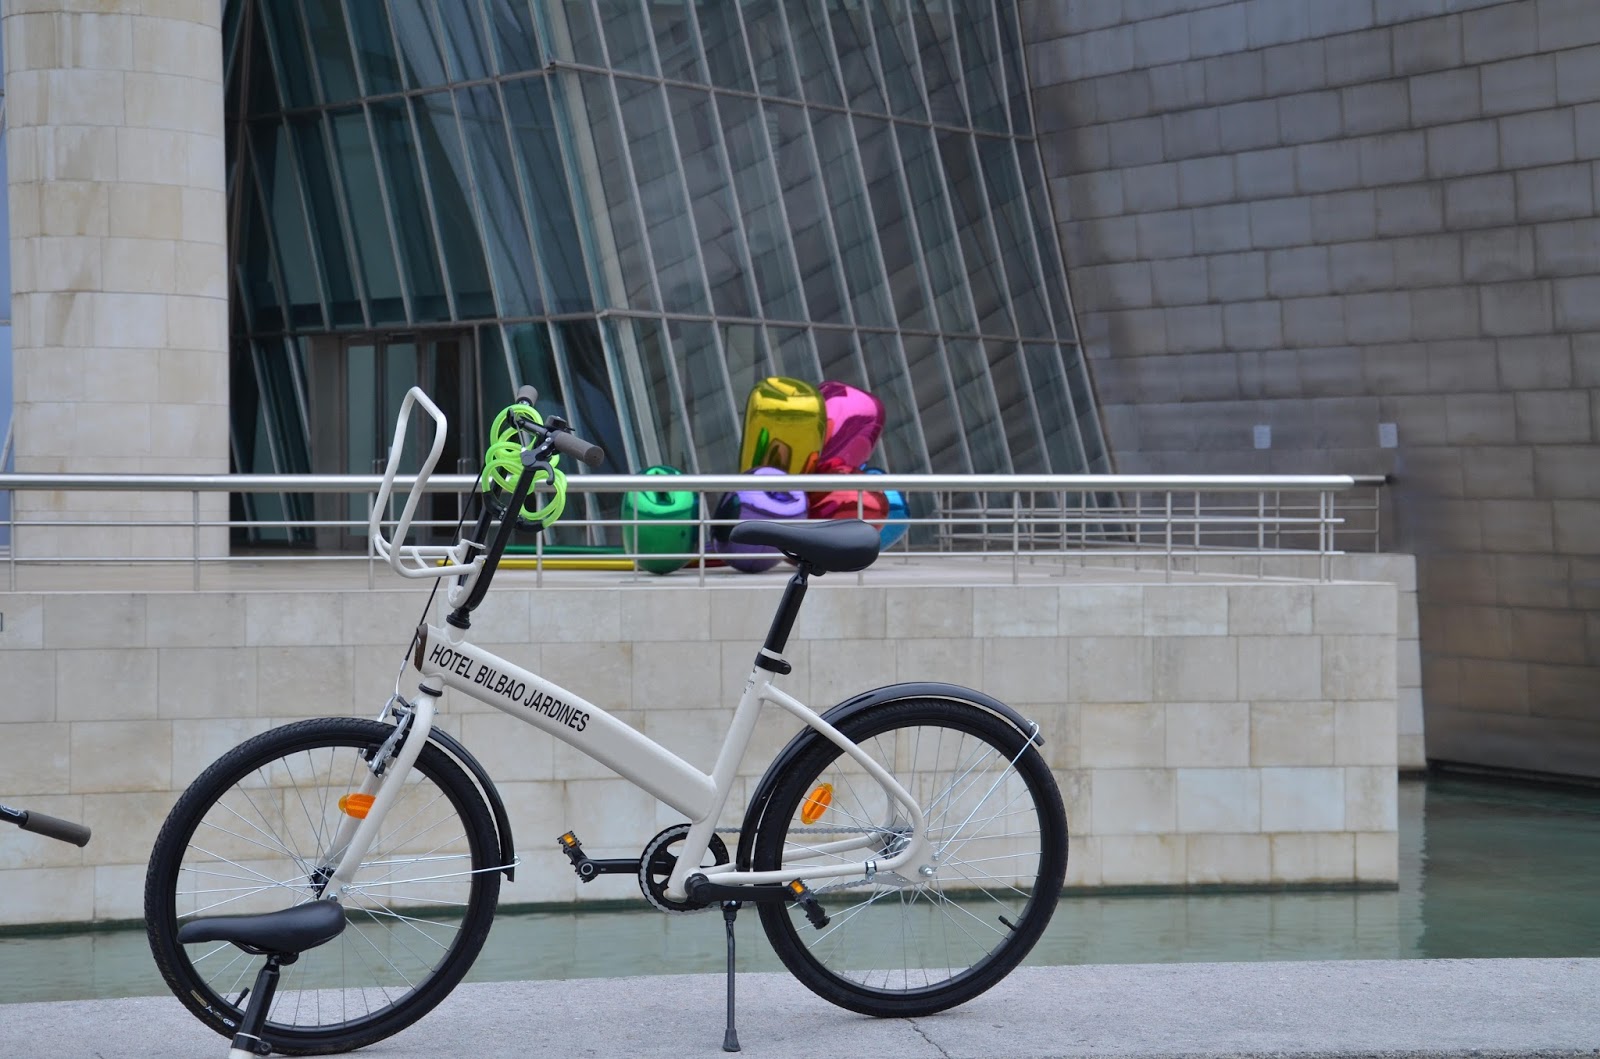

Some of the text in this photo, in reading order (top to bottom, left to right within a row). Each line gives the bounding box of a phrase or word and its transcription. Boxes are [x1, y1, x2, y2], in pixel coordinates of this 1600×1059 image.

[428, 643, 590, 732] HOTEL BILBAO JARDINES
